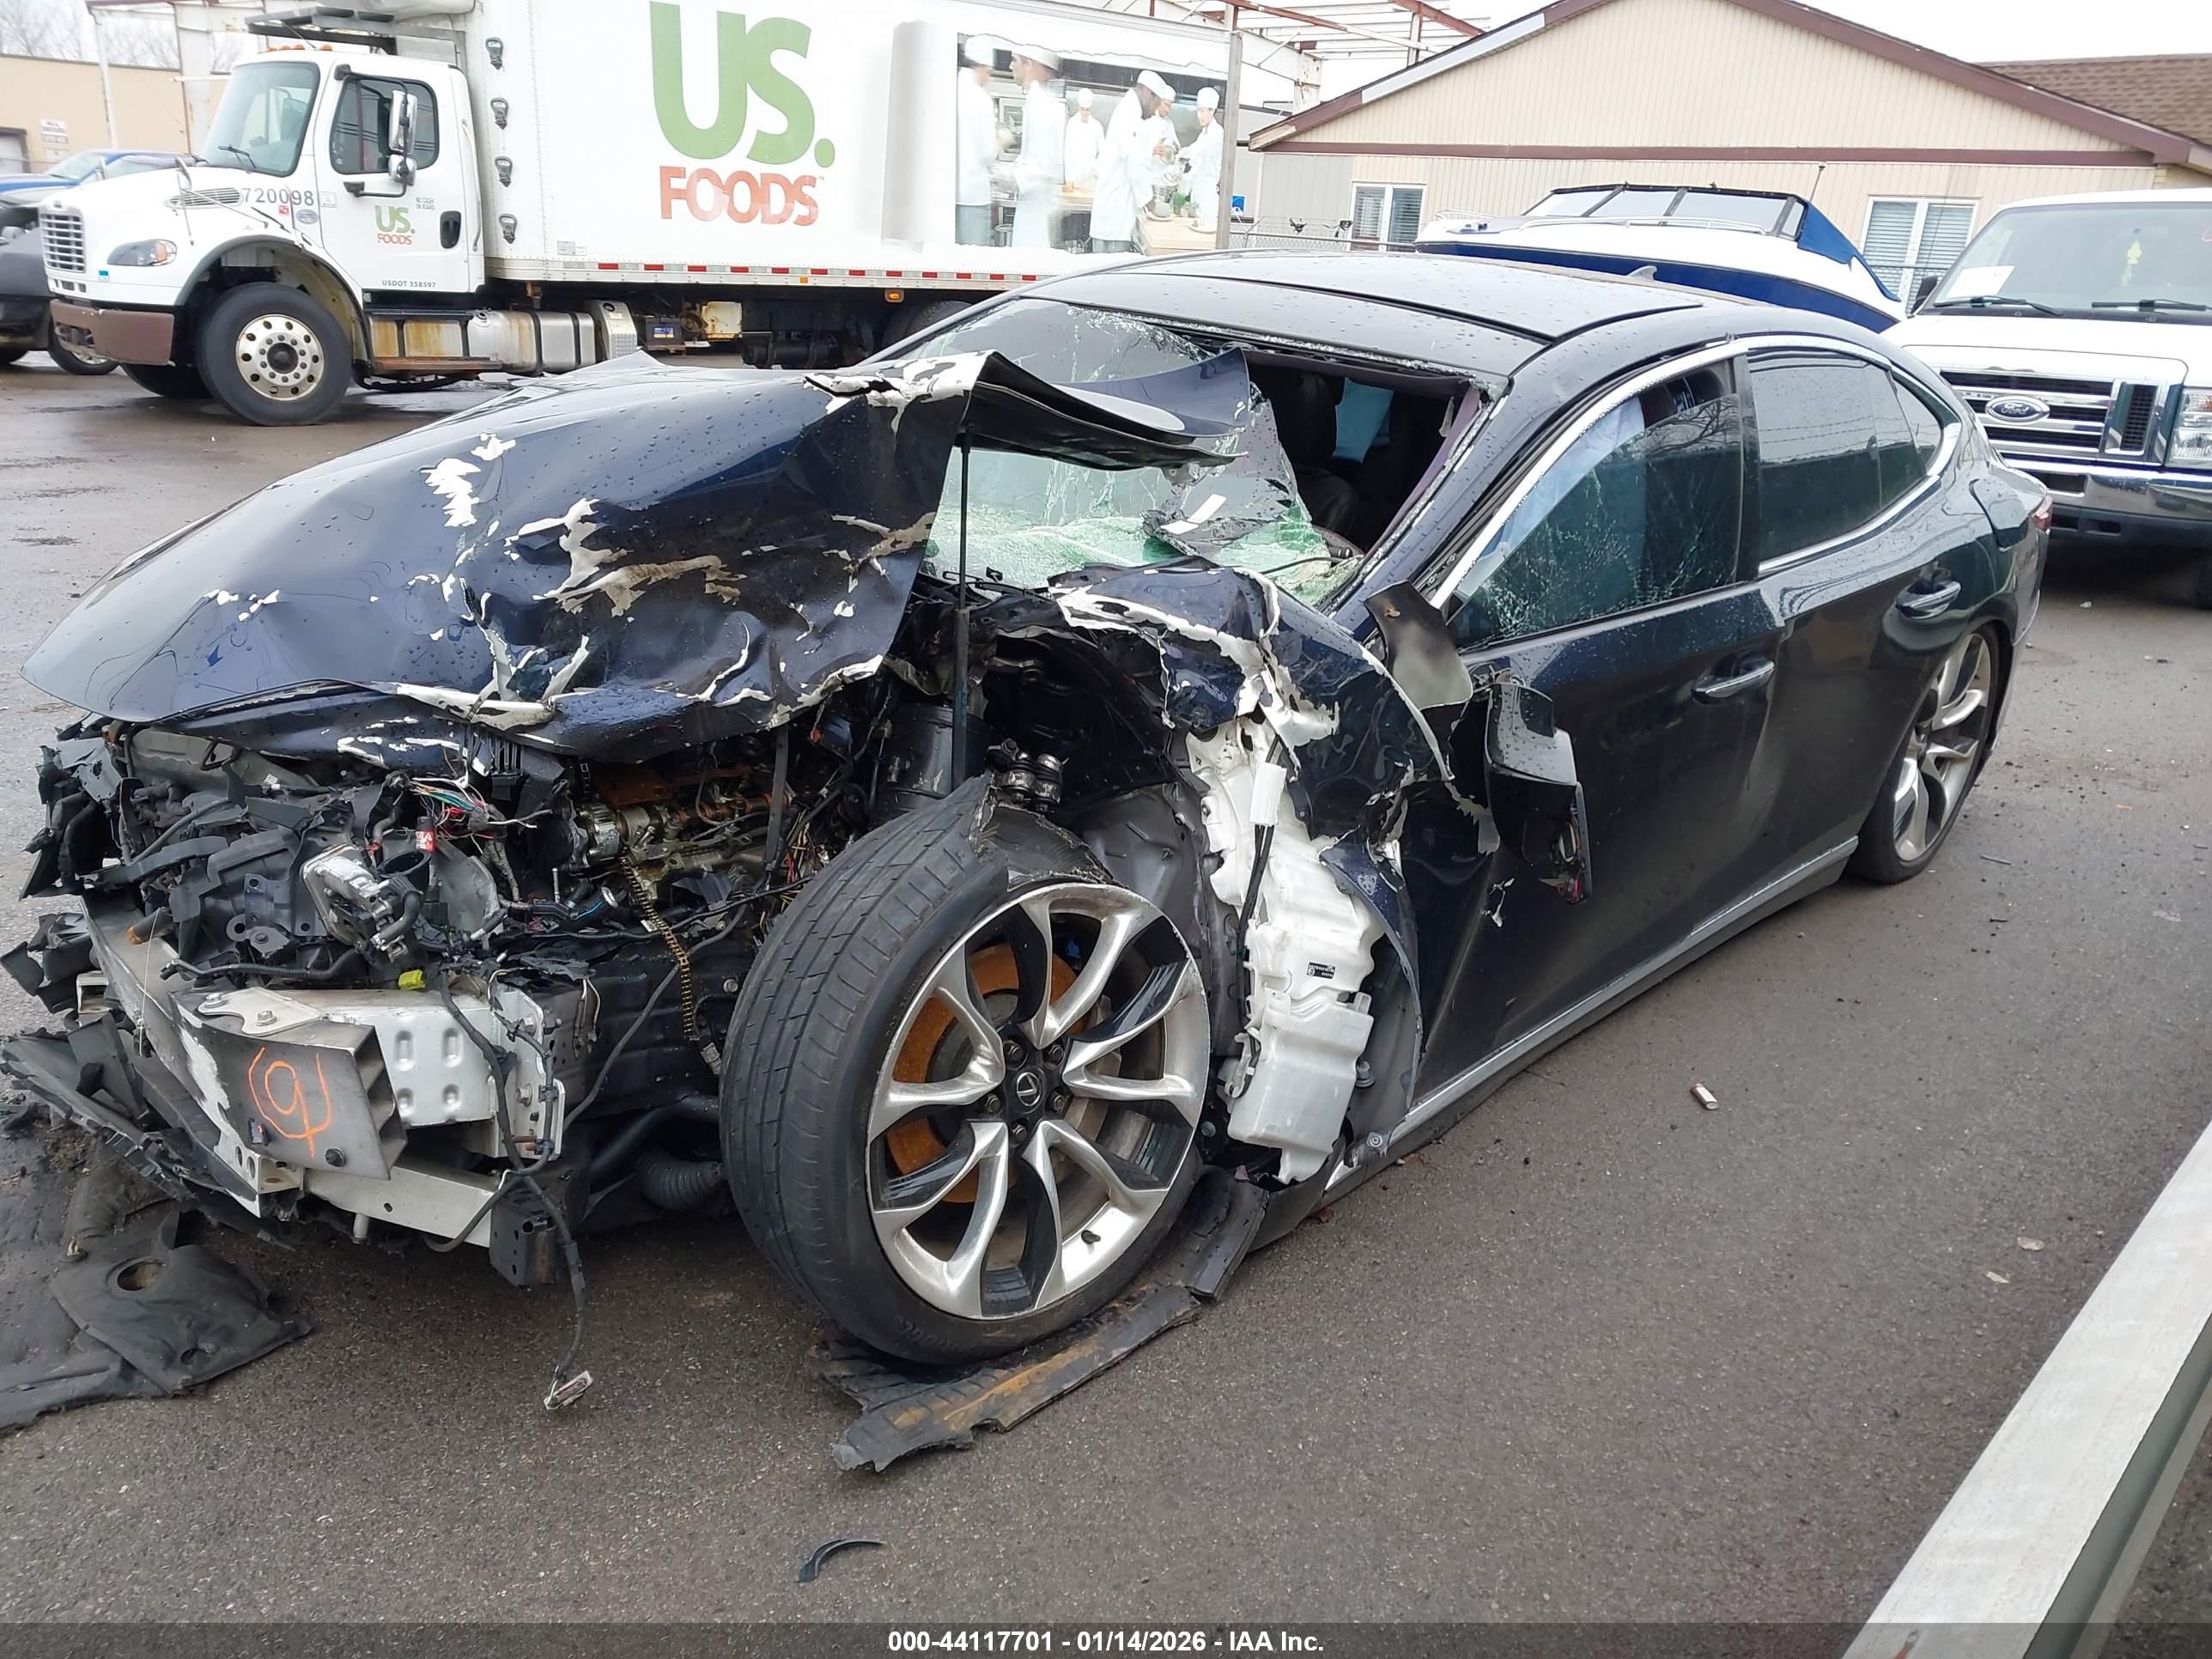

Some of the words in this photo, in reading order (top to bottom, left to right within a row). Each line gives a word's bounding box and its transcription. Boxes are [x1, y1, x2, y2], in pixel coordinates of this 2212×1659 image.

[649, 1, 836, 168] US.
[241, 187, 315, 206] 720098
[659, 165, 819, 227] FOODS
[377, 234, 412, 246] FOODS
[2002, 403, 2030, 415] Ford
